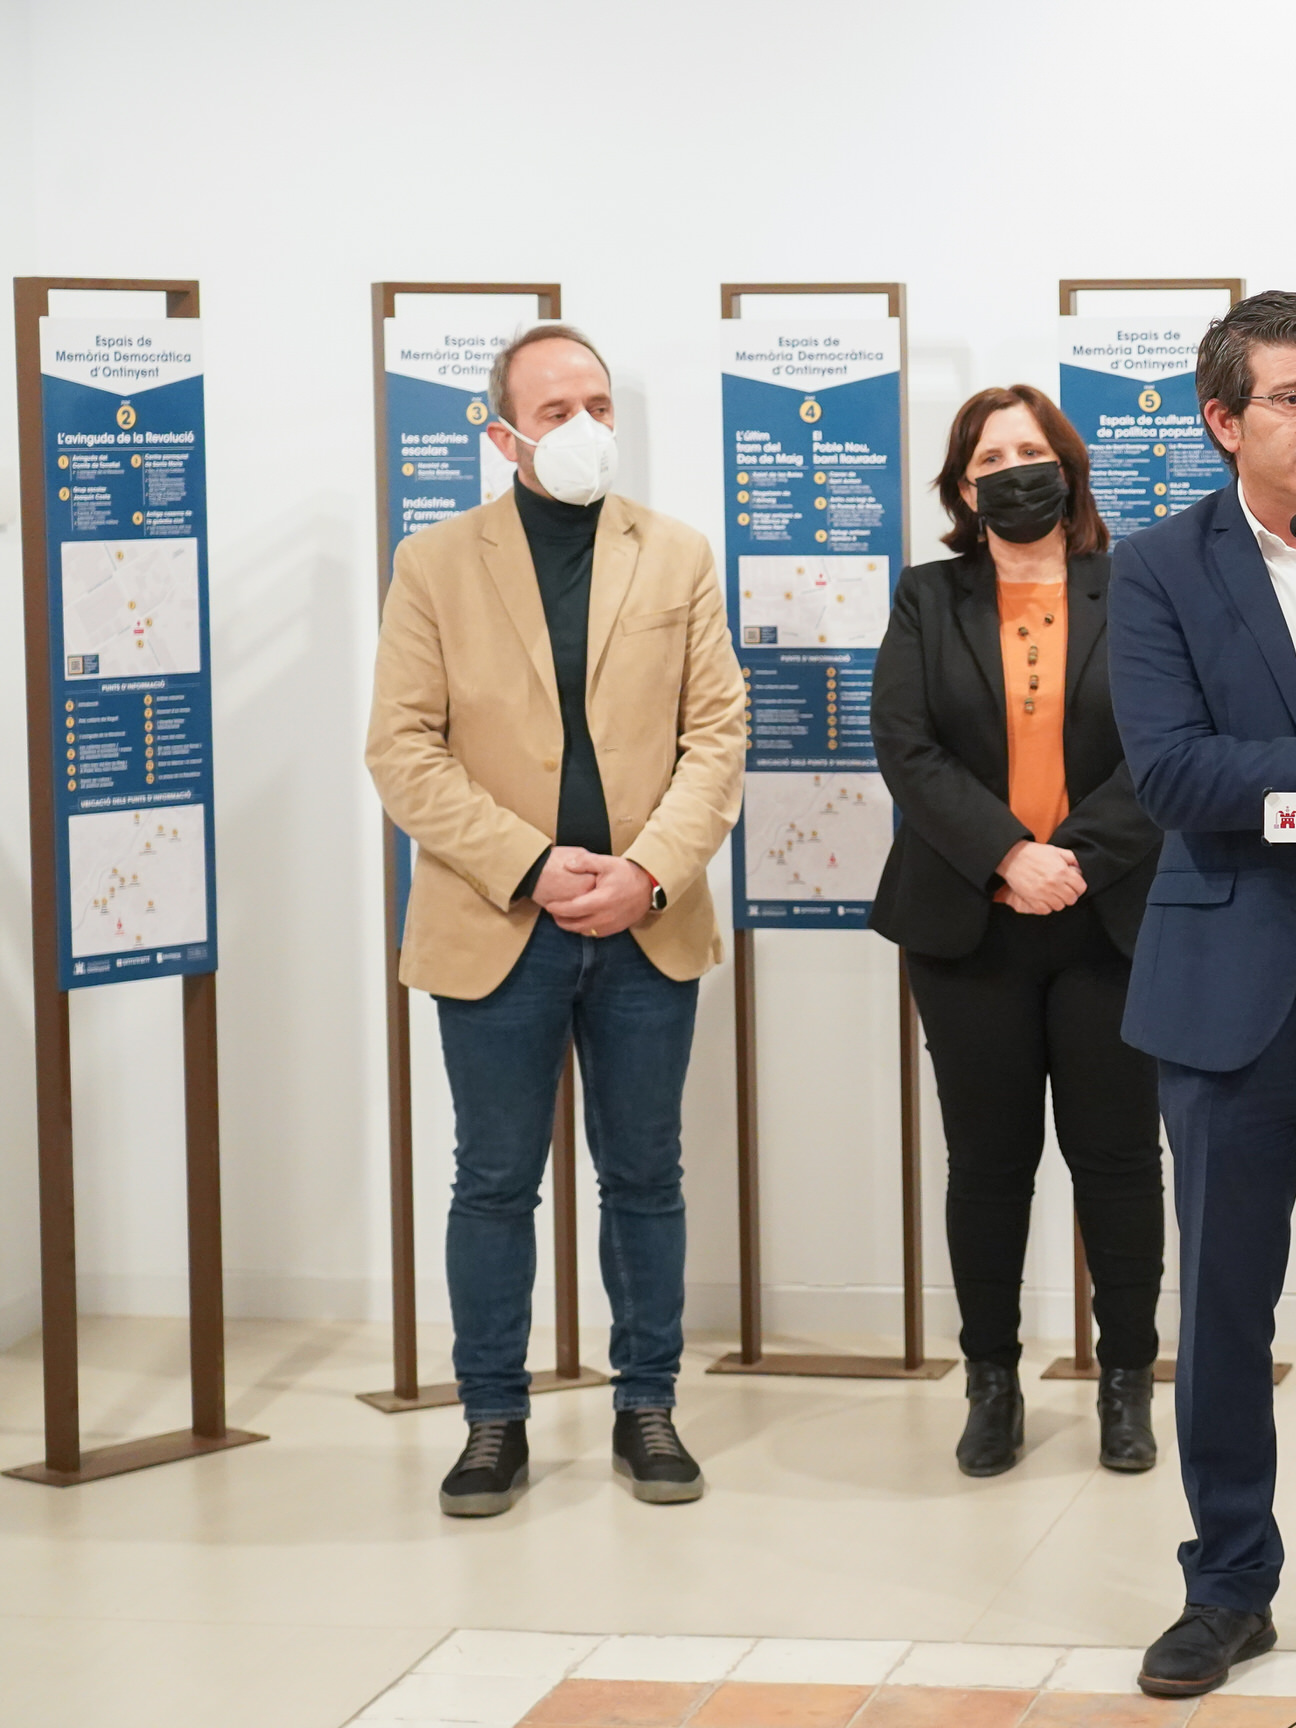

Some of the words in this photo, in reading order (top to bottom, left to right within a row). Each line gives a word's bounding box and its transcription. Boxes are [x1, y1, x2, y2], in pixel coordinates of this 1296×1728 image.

[96, 335, 135, 348] Espais
[137, 336, 151, 346] de
[445, 336, 485, 348] Espais
[490, 336, 506, 346] de
[779, 337, 818, 348] Espais
[824, 337, 840, 346] de
[1118, 331, 1159, 342] Espais
[1164, 331, 1180, 340] de
[401, 350, 459, 361] Memòria
[736, 351, 793, 361] Memòria
[798, 351, 883, 361] Democràtica
[1073, 345, 1132, 355] Memòria
[56, 351, 109, 362] Memòria
[114, 351, 191, 363] Democràtica
[1145, 394, 1155, 408] 5
[122, 410, 130, 425] 2
[472, 407, 482, 420] 3
[806, 406, 815, 418] 4
[1100, 415, 1135, 427] Espais
[1137, 415, 1152, 425] de
[58, 433, 114, 447] L'avinguda
[117, 432, 130, 443] de
[133, 432, 143, 443] la
[146, 431, 194, 443] Revolució
[402, 433, 419, 444] Les
[422, 432, 469, 444] colònies
[1097, 428, 1113, 438] de
[1159, 428, 1204, 439] popular
[402, 445, 448, 456] escolars
[759, 454, 774, 464] de
[776, 453, 803, 466] Maig
[403, 497, 456, 509] Indústries
